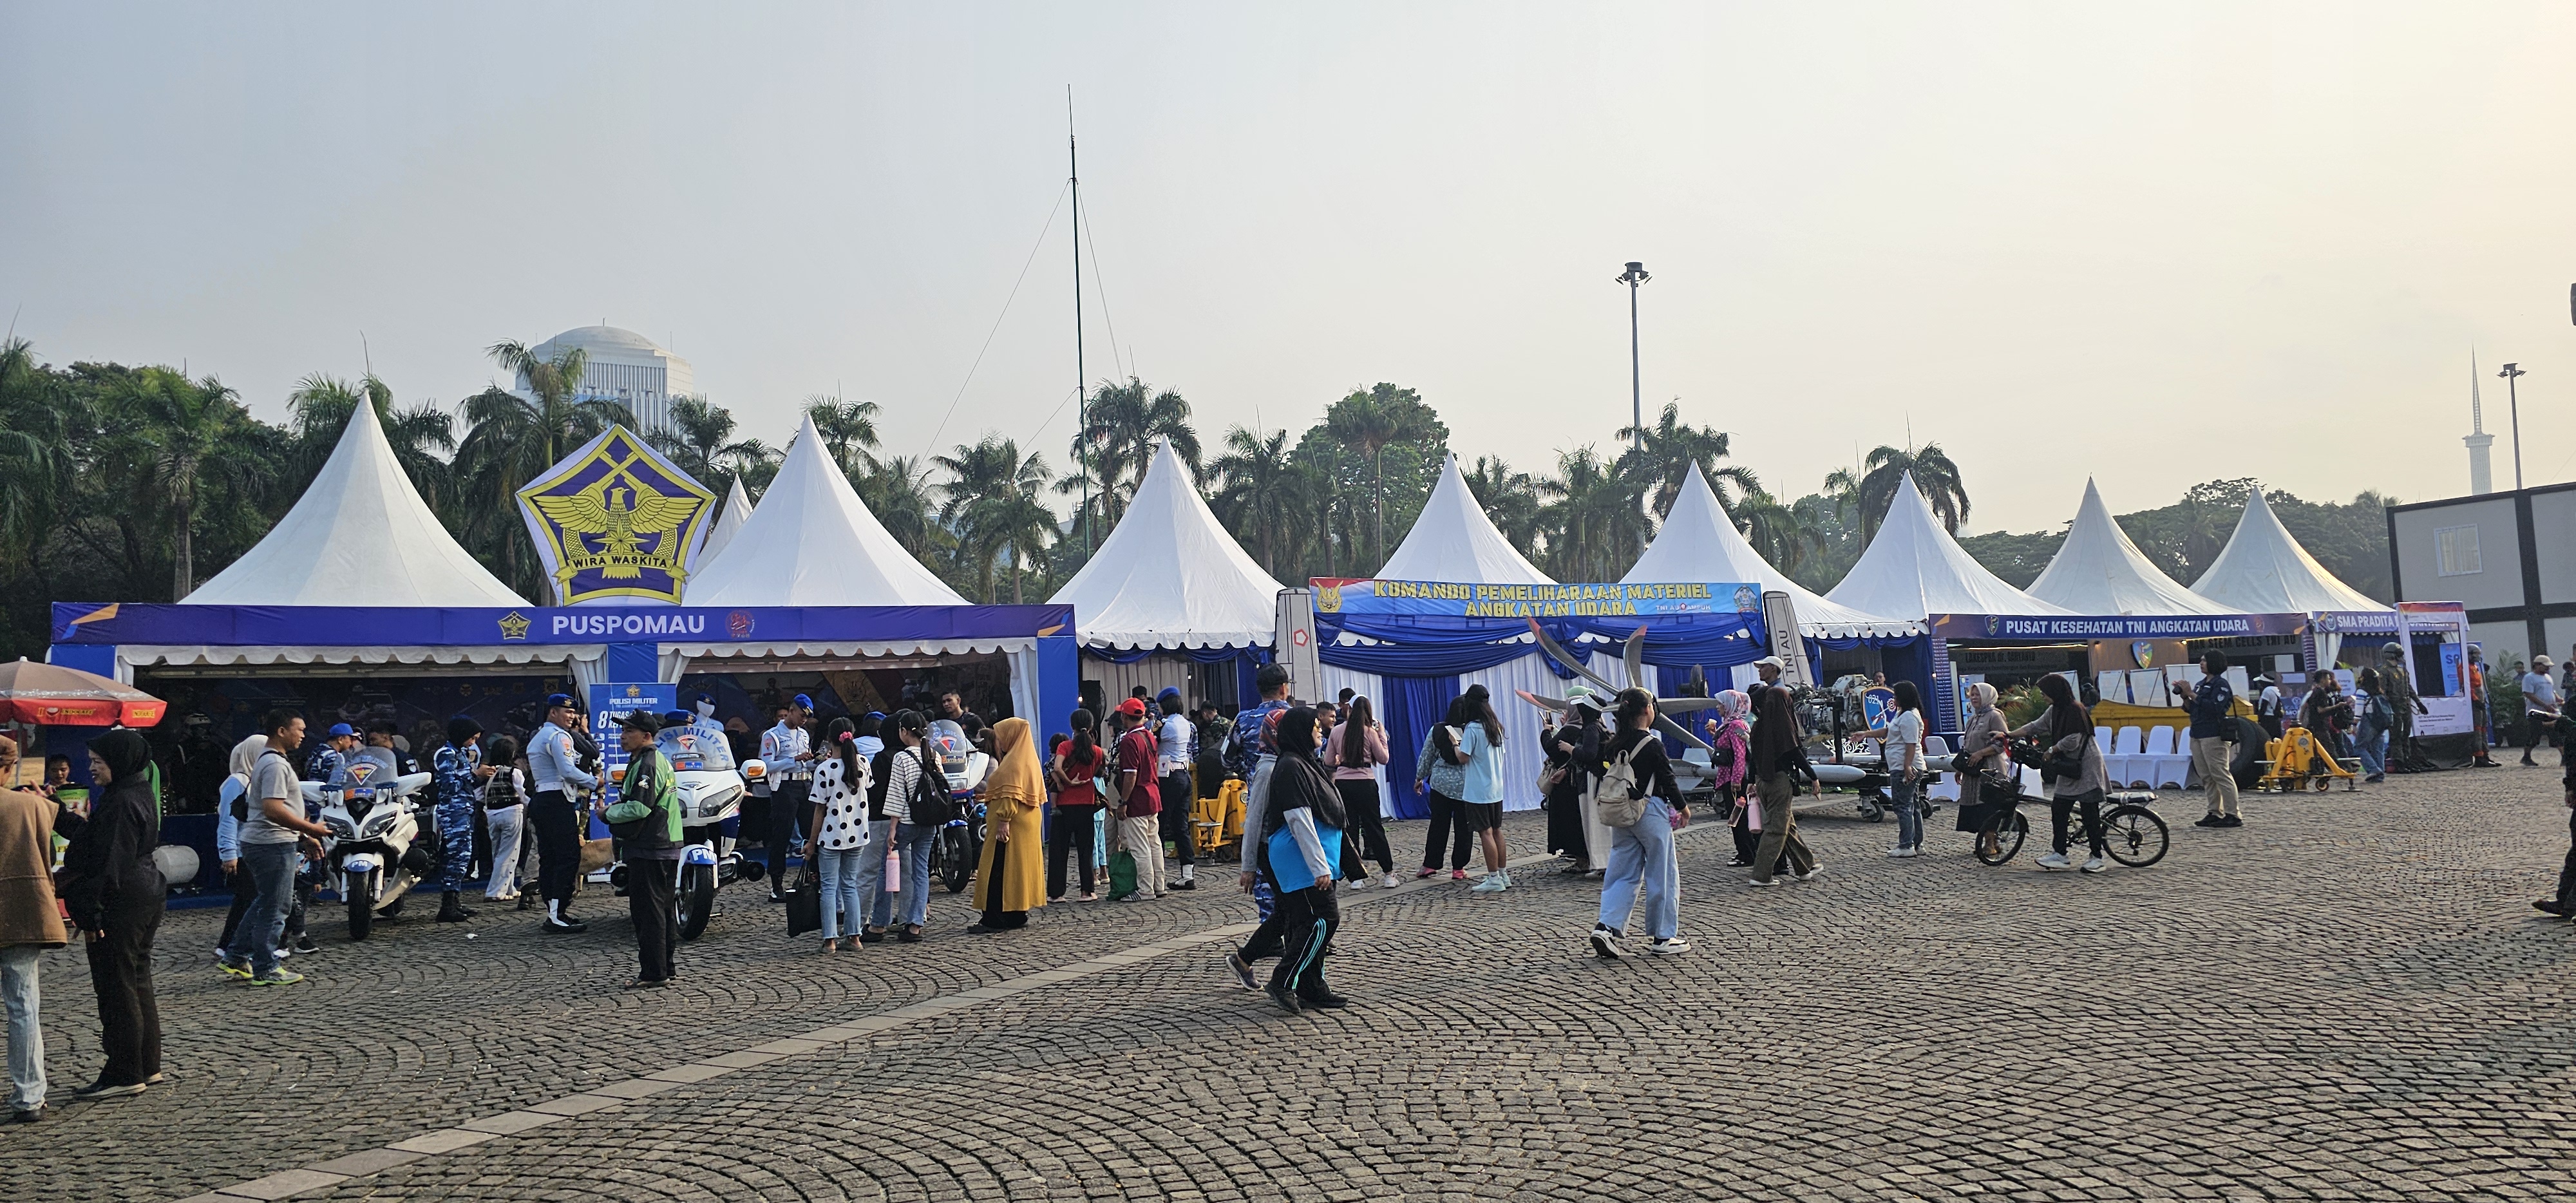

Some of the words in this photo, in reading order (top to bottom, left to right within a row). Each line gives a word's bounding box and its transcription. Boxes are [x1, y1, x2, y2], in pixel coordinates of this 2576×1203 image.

[573, 556, 607, 568] WIRA
[611, 556, 667, 567] WASKITA
[1374, 580, 1470, 600] KOMANDO
[1476, 584, 1622, 601] PEMELIHARAAN
[1627, 584, 1712, 600] MATERIEL
[1464, 601, 1569, 617] ANGKATAN
[1576, 601, 1637, 616] UDARA
[553, 615, 705, 634] PUSPOMAU
[2006, 621, 2048, 633] PUSAT
[2051, 621, 2123, 634] KESEHATAN
[2126, 621, 2146, 633] TNI
[2149, 620, 2210, 633] ANGKATAN
[2213, 619, 2249, 632] UDARA
[2337, 615, 2358, 627] SMA
[2358, 615, 2393, 627] PRADITA
[1779, 630, 1790, 649] AU
[1783, 654, 1794, 676] TNI
[598, 710, 609, 728] 8
[683, 727, 729, 762] MILITER
[691, 848, 716, 862] PM
